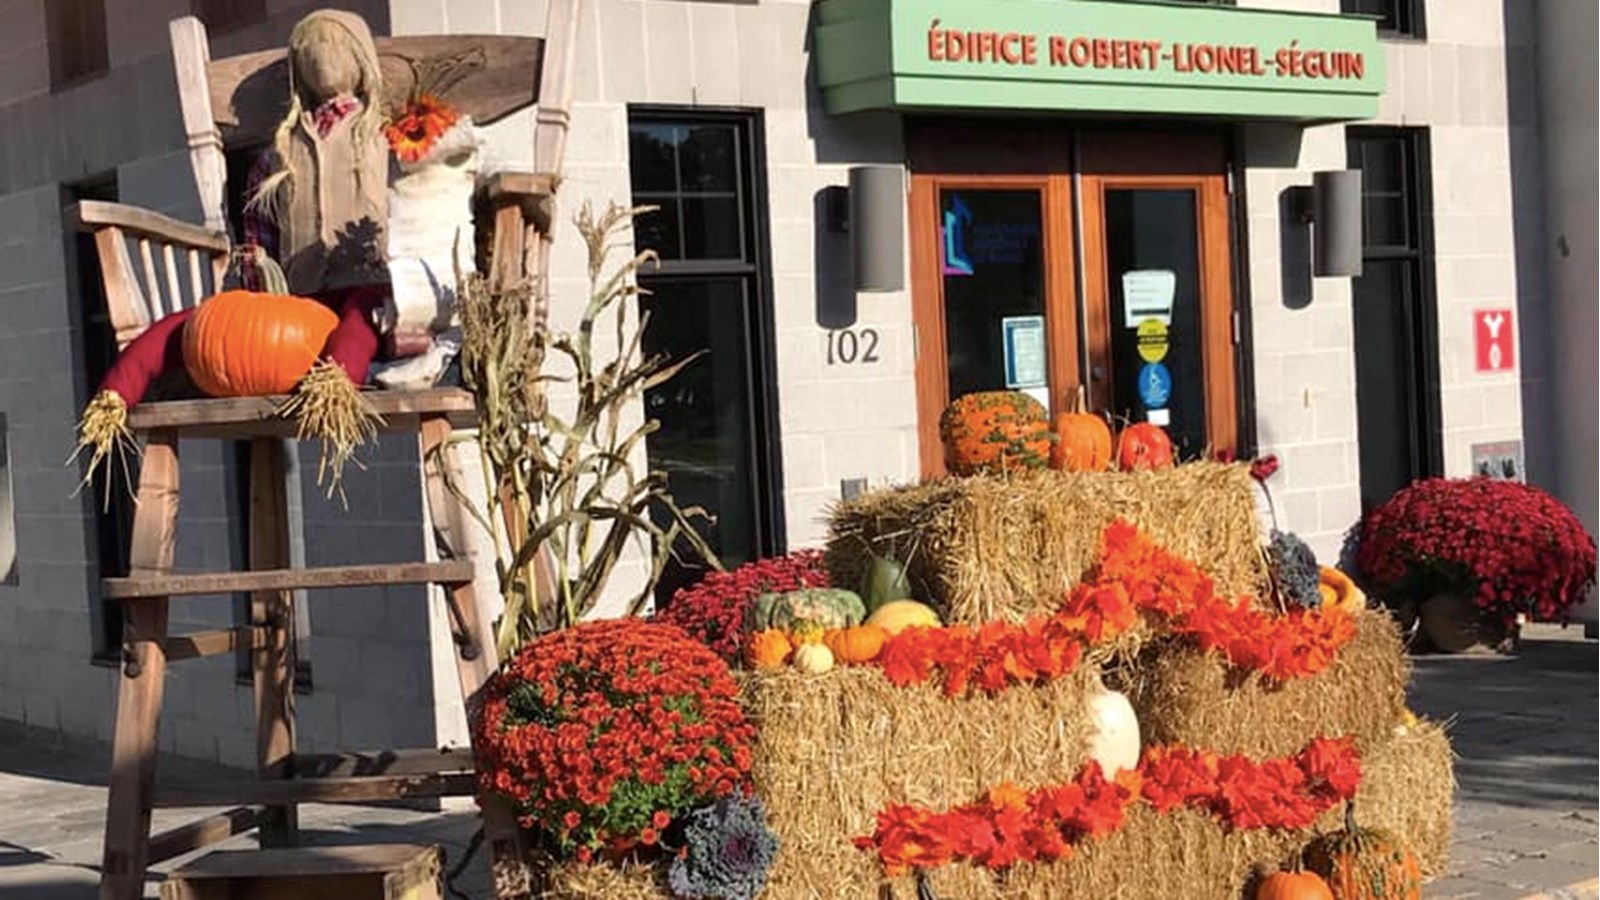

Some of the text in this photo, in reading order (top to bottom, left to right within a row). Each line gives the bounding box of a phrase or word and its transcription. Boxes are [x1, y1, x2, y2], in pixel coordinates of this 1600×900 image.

[928, 18, 1365, 79] ÉDIFICE ROBERT-LIONEL-SÉGUIN
[827, 328, 879, 365] 102
